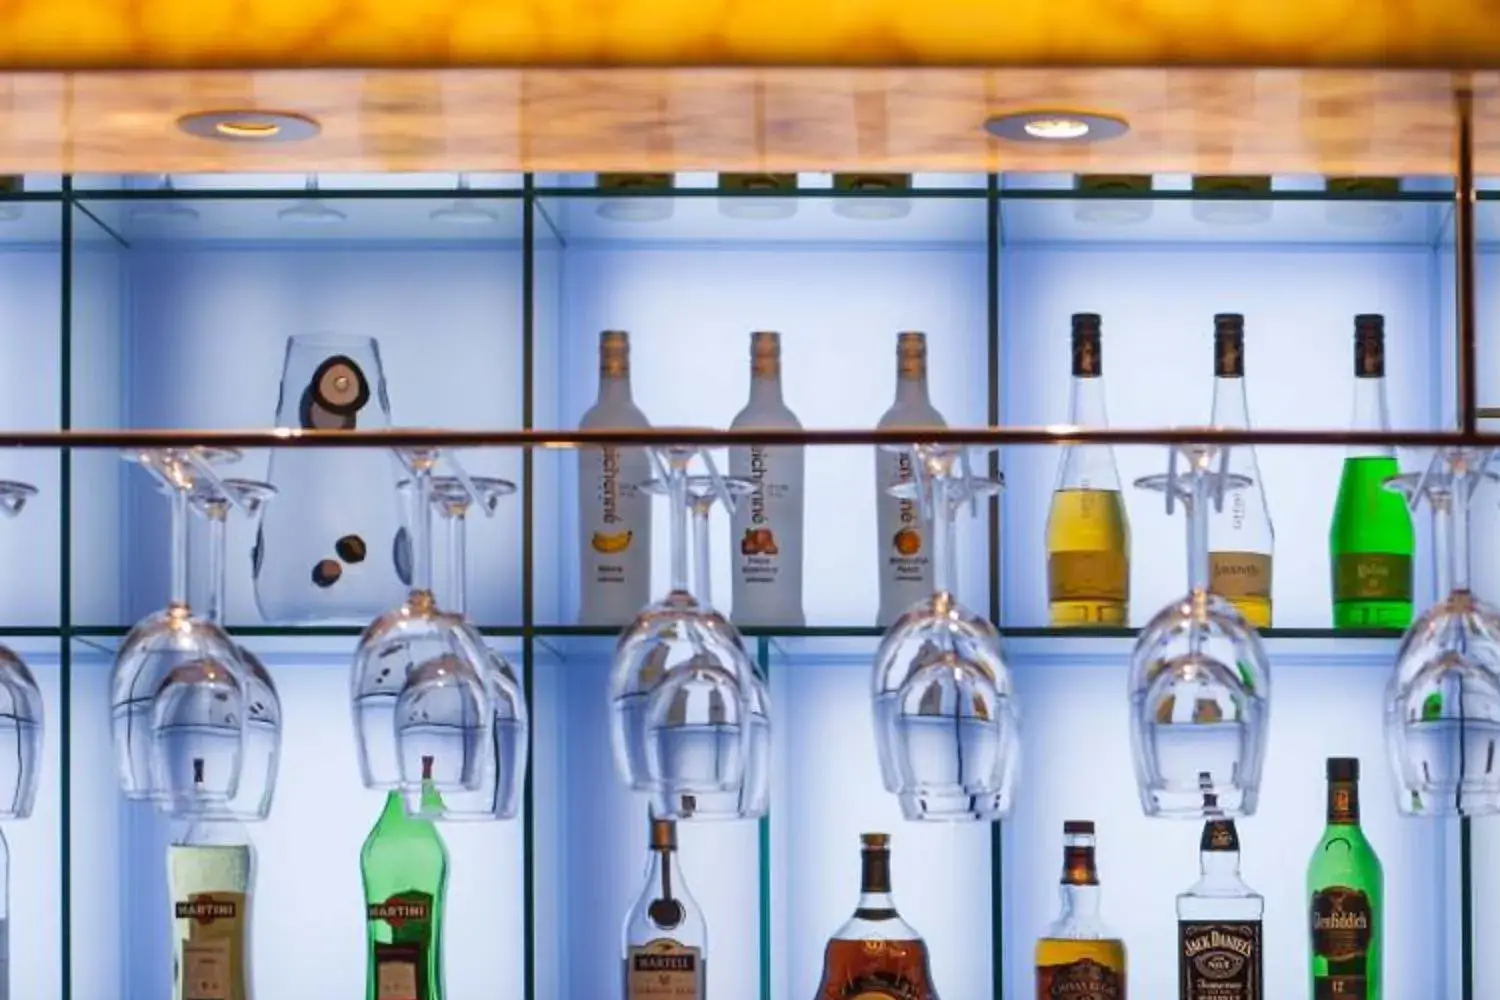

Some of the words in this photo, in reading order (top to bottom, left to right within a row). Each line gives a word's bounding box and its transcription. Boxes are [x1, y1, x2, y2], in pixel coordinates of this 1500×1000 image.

[178, 903, 234, 915] MARTINI
[369, 905, 425, 917] MARTINI
[1185, 934, 1210, 957] JACK
[638, 957, 689, 968] MARTELL
